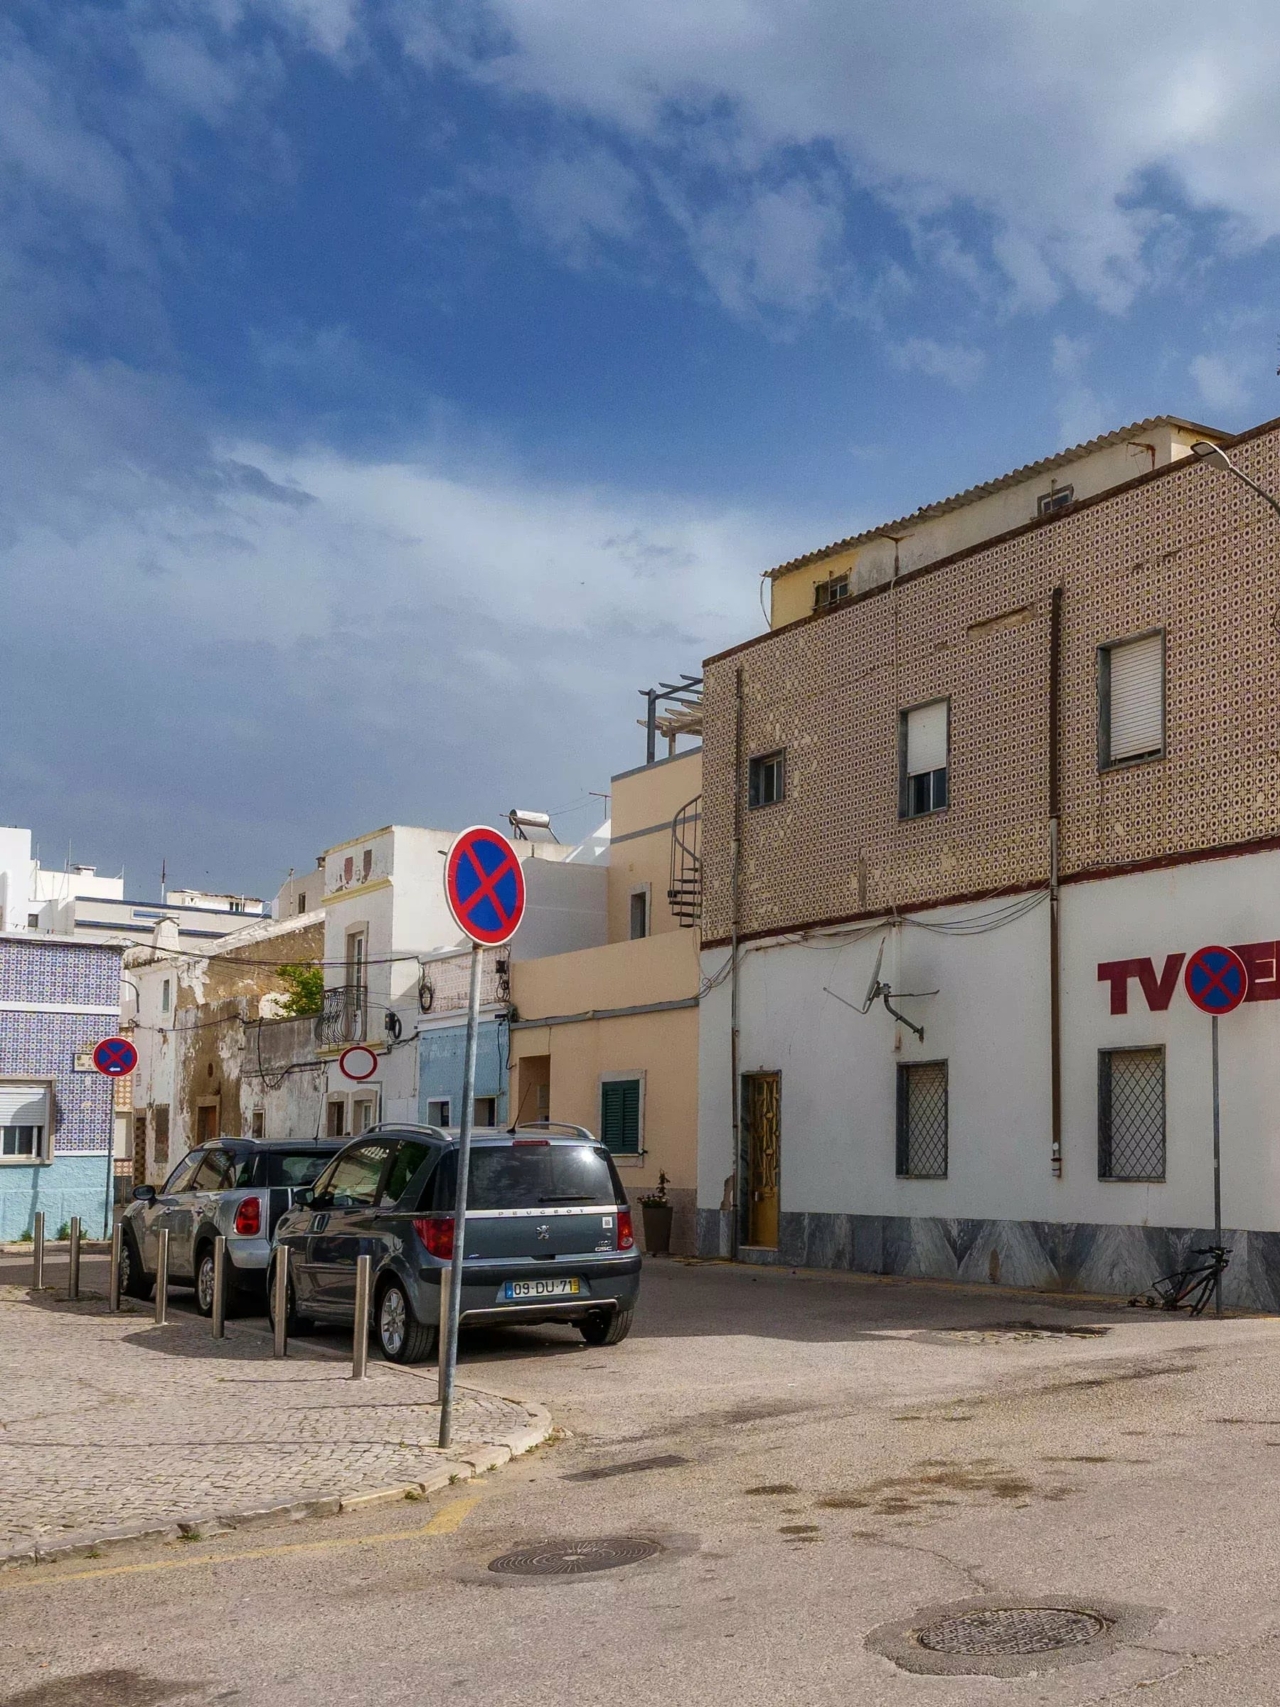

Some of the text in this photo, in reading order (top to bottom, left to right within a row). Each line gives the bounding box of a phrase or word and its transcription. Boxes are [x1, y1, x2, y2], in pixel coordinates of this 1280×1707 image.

[1097, 952, 1187, 1016] TV
[498, 1208, 585, 1216] PEUGEOT
[514, 1280, 573, 1296] 09-DU-71
